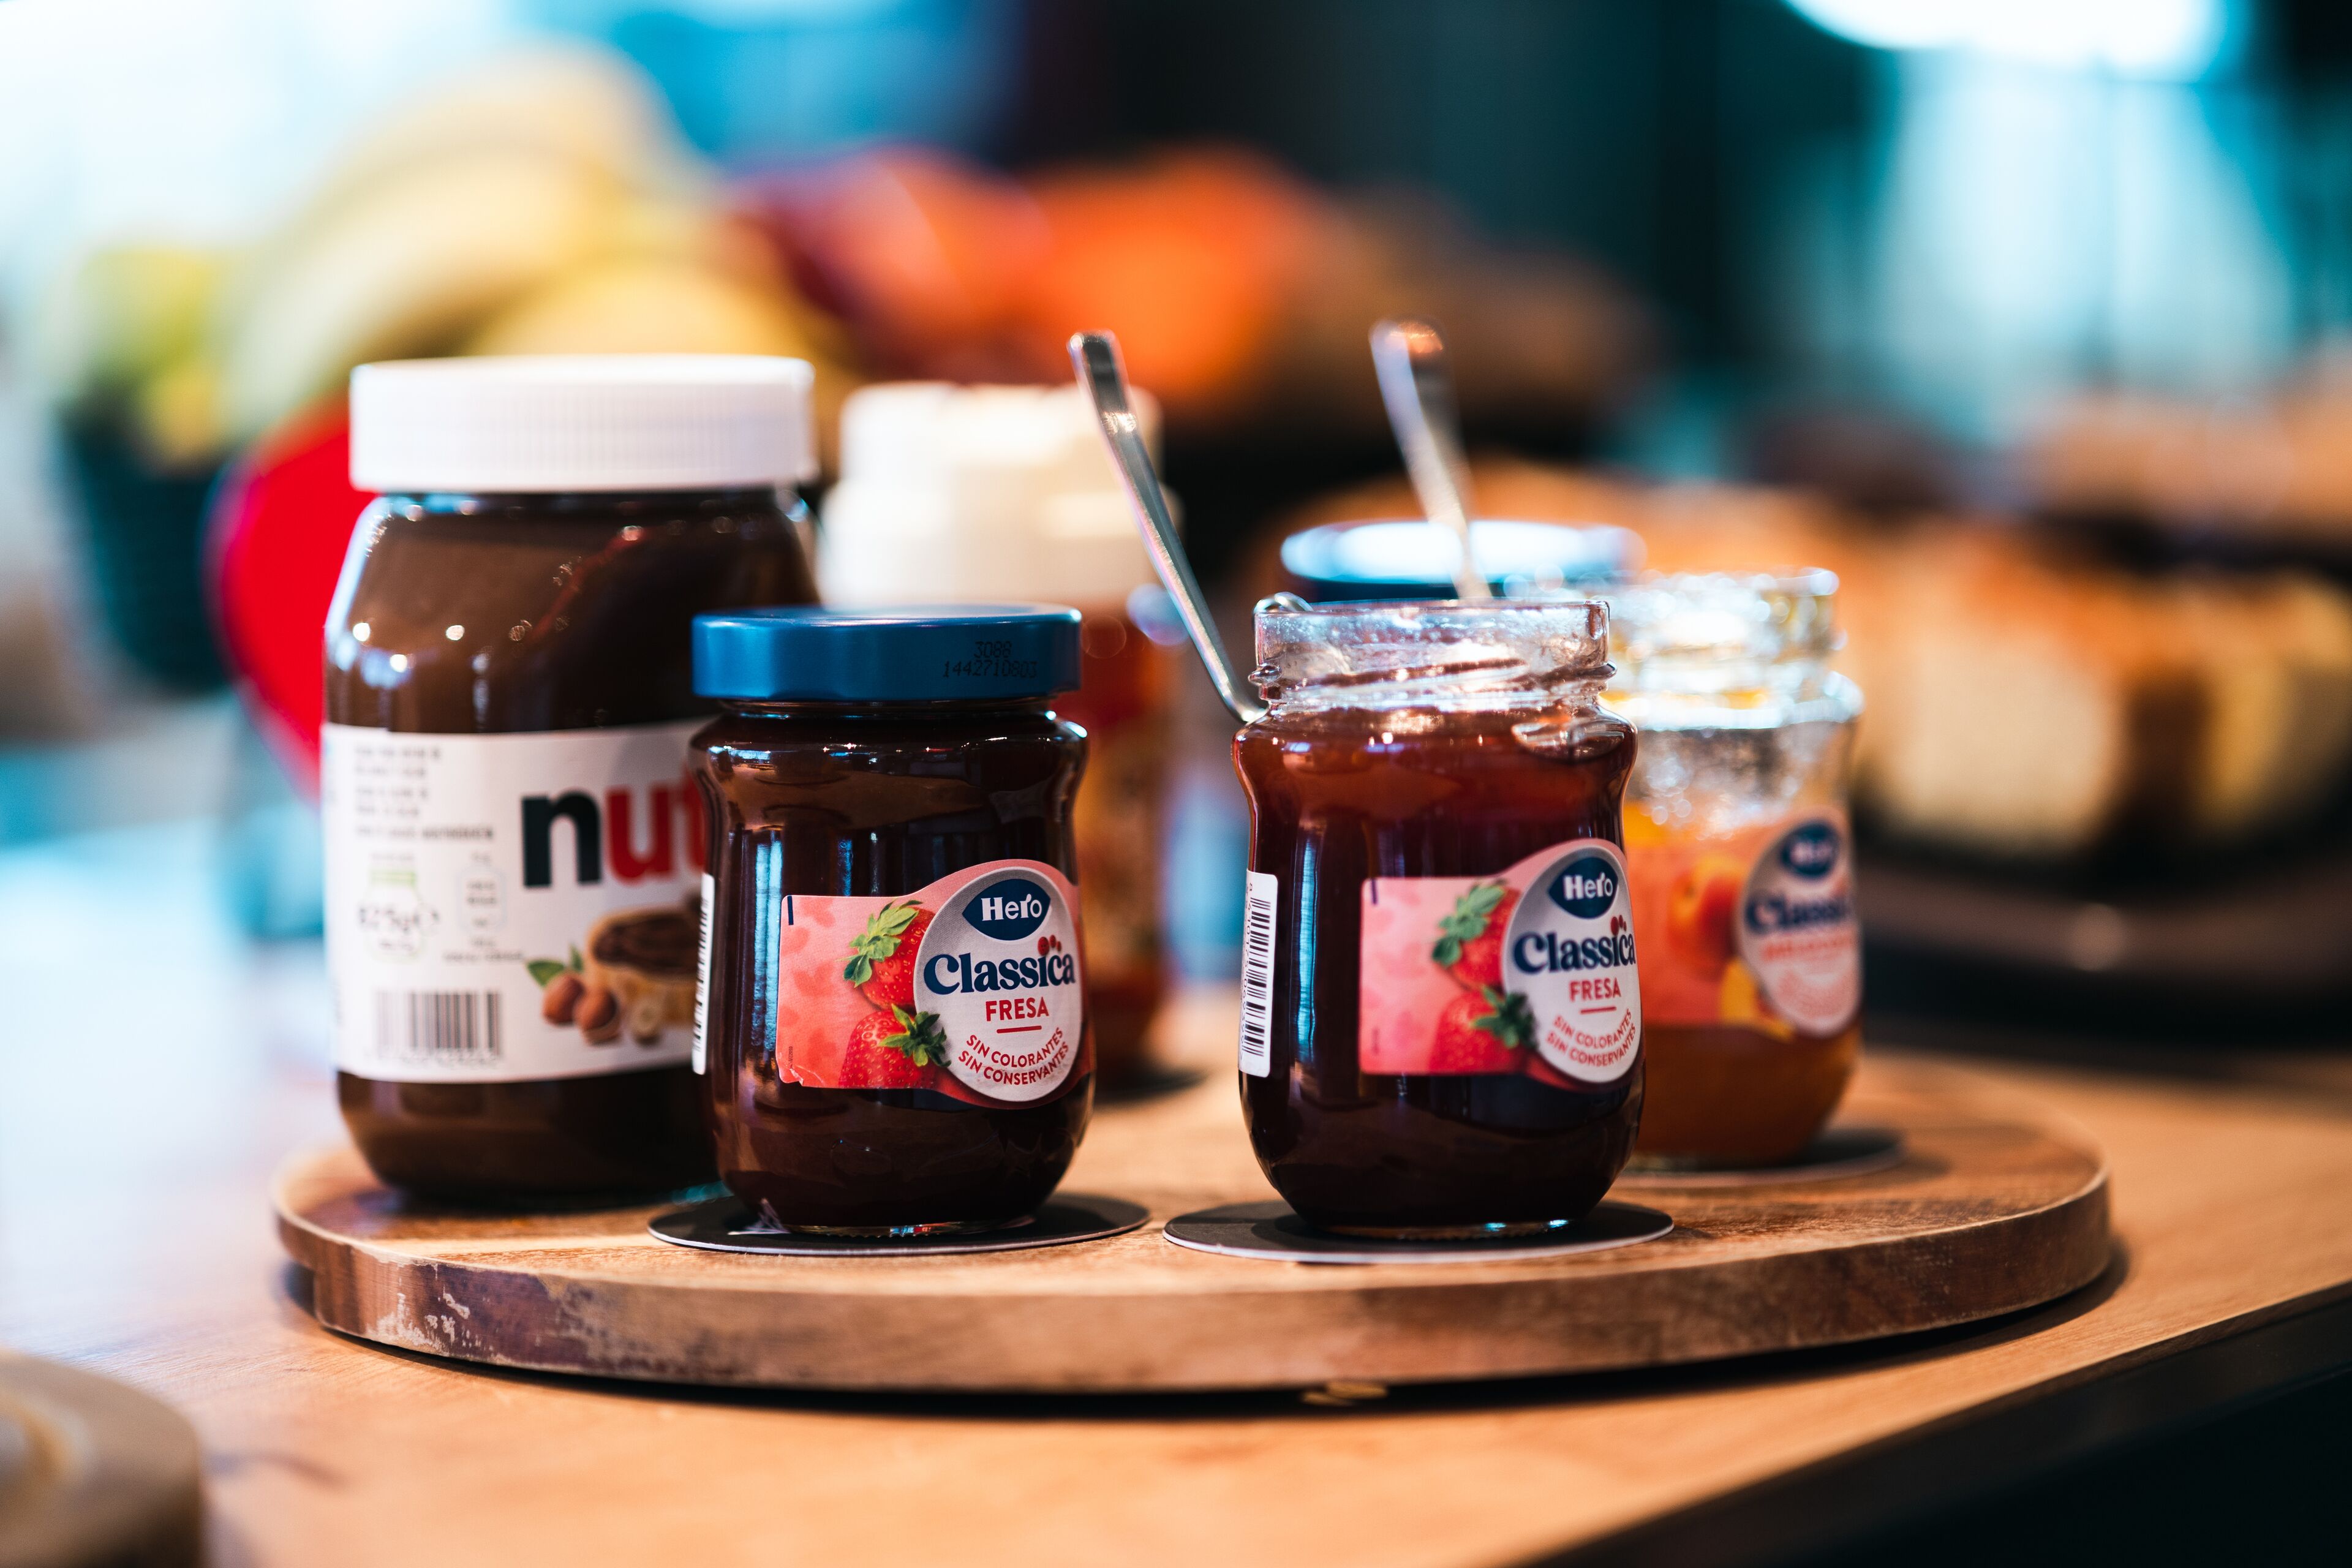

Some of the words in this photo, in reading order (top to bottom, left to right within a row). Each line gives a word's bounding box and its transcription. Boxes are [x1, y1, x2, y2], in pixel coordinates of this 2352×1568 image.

[973, 640, 1012, 658] 3088
[981, 893, 1042, 921] Hero
[1564, 872, 1613, 901] Hero
[923, 951, 1076, 995] Classica
[1513, 931, 1636, 975] Classica
[986, 997, 1049, 1022] FRESA
[1569, 977, 1621, 1002] FRESA
[967, 1035, 990, 1058] SIN
[991, 1027, 1063, 1068] COLORANTES
[1547, 1031, 1567, 1054] SIN
[1569, 1023, 1635, 1066] CONSERVANTES
[1553, 1016, 1575, 1038] SIN
[1575, 1008, 1631, 1049] COLORANTES
[958, 1050, 982, 1073] SIN
[984, 1042, 1068, 1085] CONSERVANTES
